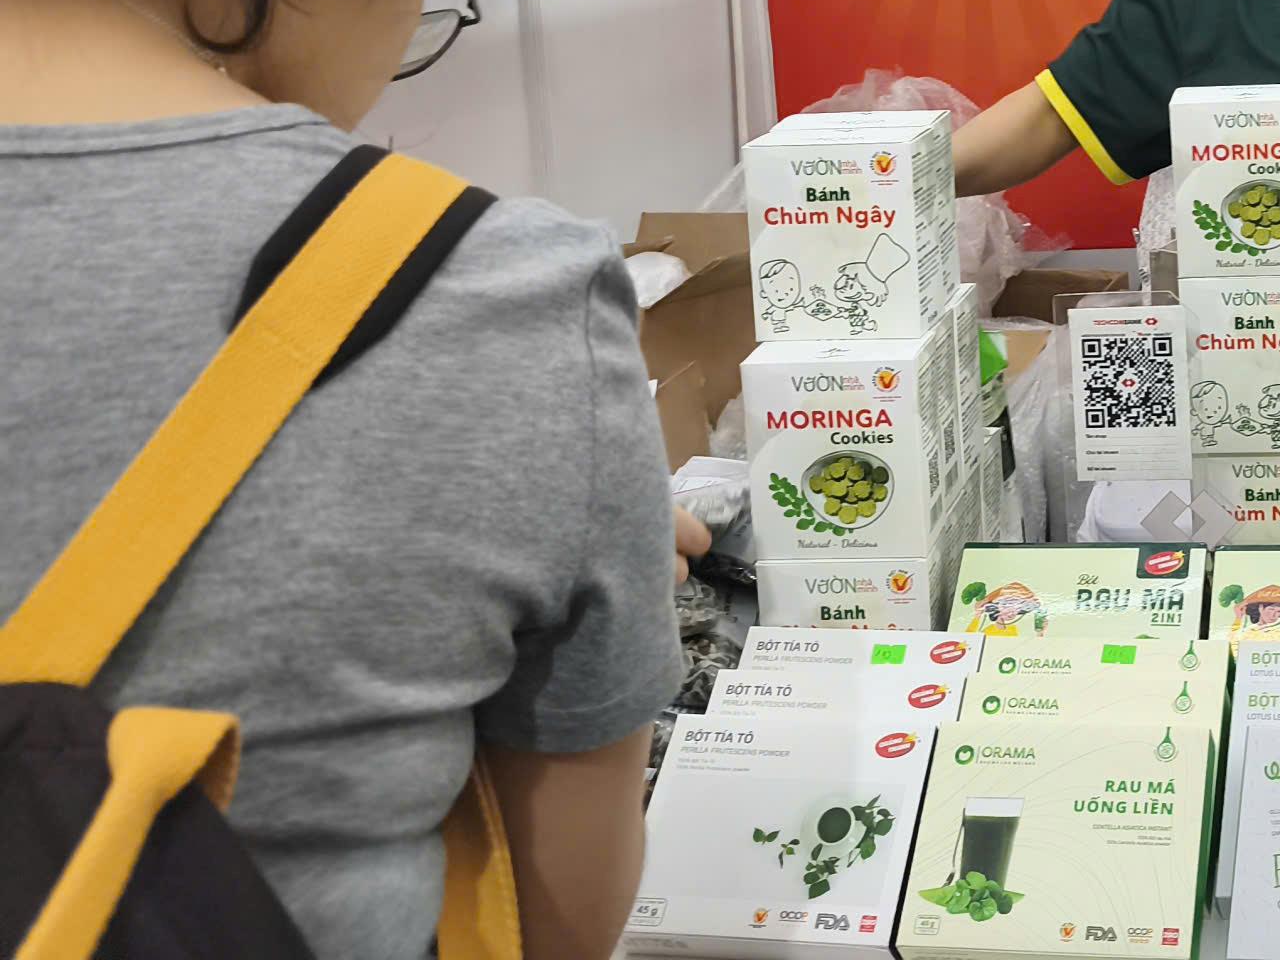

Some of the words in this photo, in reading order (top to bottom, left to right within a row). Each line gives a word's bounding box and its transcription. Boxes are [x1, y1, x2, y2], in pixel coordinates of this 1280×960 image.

[806, 187, 850, 202] Bánh
[764, 207, 829, 225] Chùm
[837, 206, 896, 228] Ngây
[1234, 317, 1274, 330] Bánh
[1196, 334, 1255, 350] Chùm
[767, 409, 892, 430] MORINGA
[831, 431, 893, 445] Cookies
[684, 730, 712, 744] BỘT
[715, 730, 734, 742] TÍA
[737, 732, 754, 744] TÔ
[981, 747, 1035, 760] ORAMA
[1105, 780, 1142, 793] RAU
[1147, 778, 1175, 794] MÁ
[1074, 796, 1127, 815] UỐNG
[1133, 796, 1174, 815] LIỀN
[815, 913, 850, 931] FDA
[1085, 926, 1117, 942] FDA
